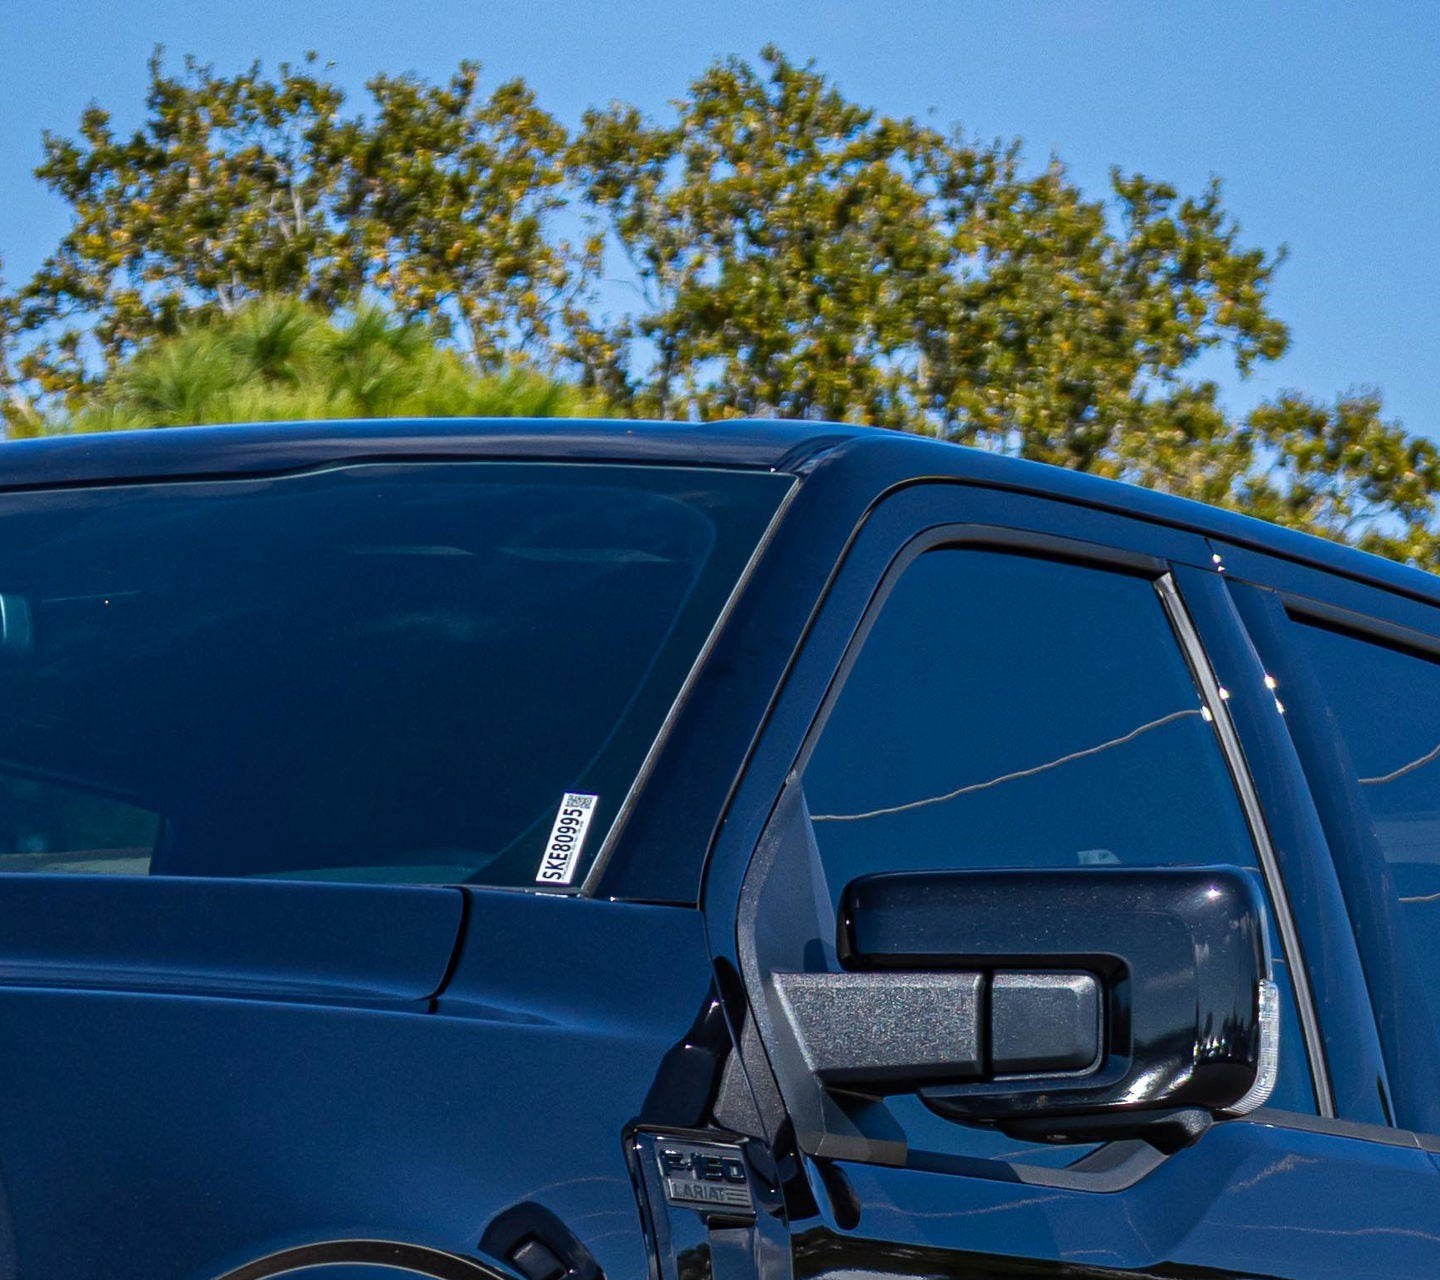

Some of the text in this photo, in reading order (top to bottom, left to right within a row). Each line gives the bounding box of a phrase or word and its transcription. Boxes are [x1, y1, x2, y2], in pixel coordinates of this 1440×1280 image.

[542, 808, 583, 880] SKE80995
[661, 1149, 747, 1184] F-150
[673, 1184, 726, 1201] LARIAT
